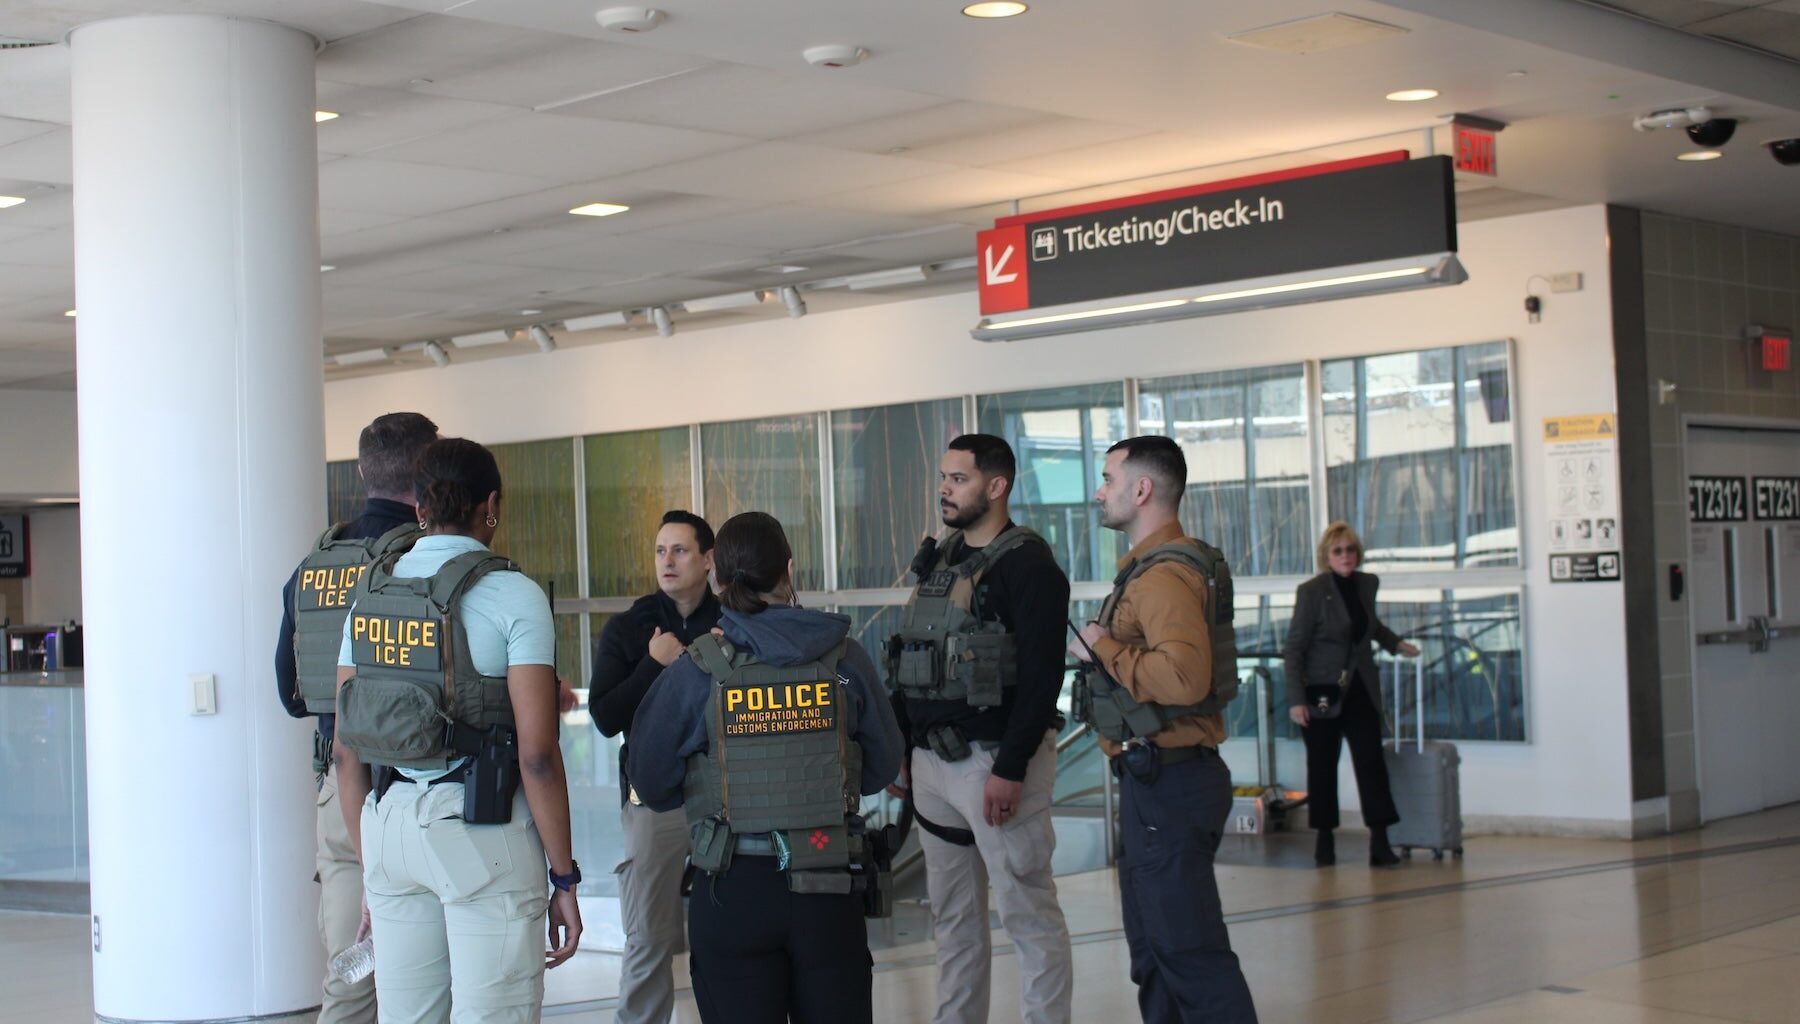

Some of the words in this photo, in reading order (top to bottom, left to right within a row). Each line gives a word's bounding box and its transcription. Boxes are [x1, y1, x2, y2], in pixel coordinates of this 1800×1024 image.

[1458, 129, 1494, 174] EXIT
[1063, 196, 1284, 252] Ticketing/Check-In
[1763, 336, 1790, 369] EXIT
[0, 565, 17, 576] ator
[318, 589, 347, 607] ICE
[353, 616, 436, 647] POLICE
[374, 644, 411, 666] ICE
[726, 682, 831, 712] POLICE
[726, 722, 768, 734] CUSTOMS
[771, 717, 833, 732] ENFORCEMENT
[735, 710, 798, 723] IMMIGRATION
[802, 708, 821, 718] AND
[1240, 816, 1255, 831] 19
